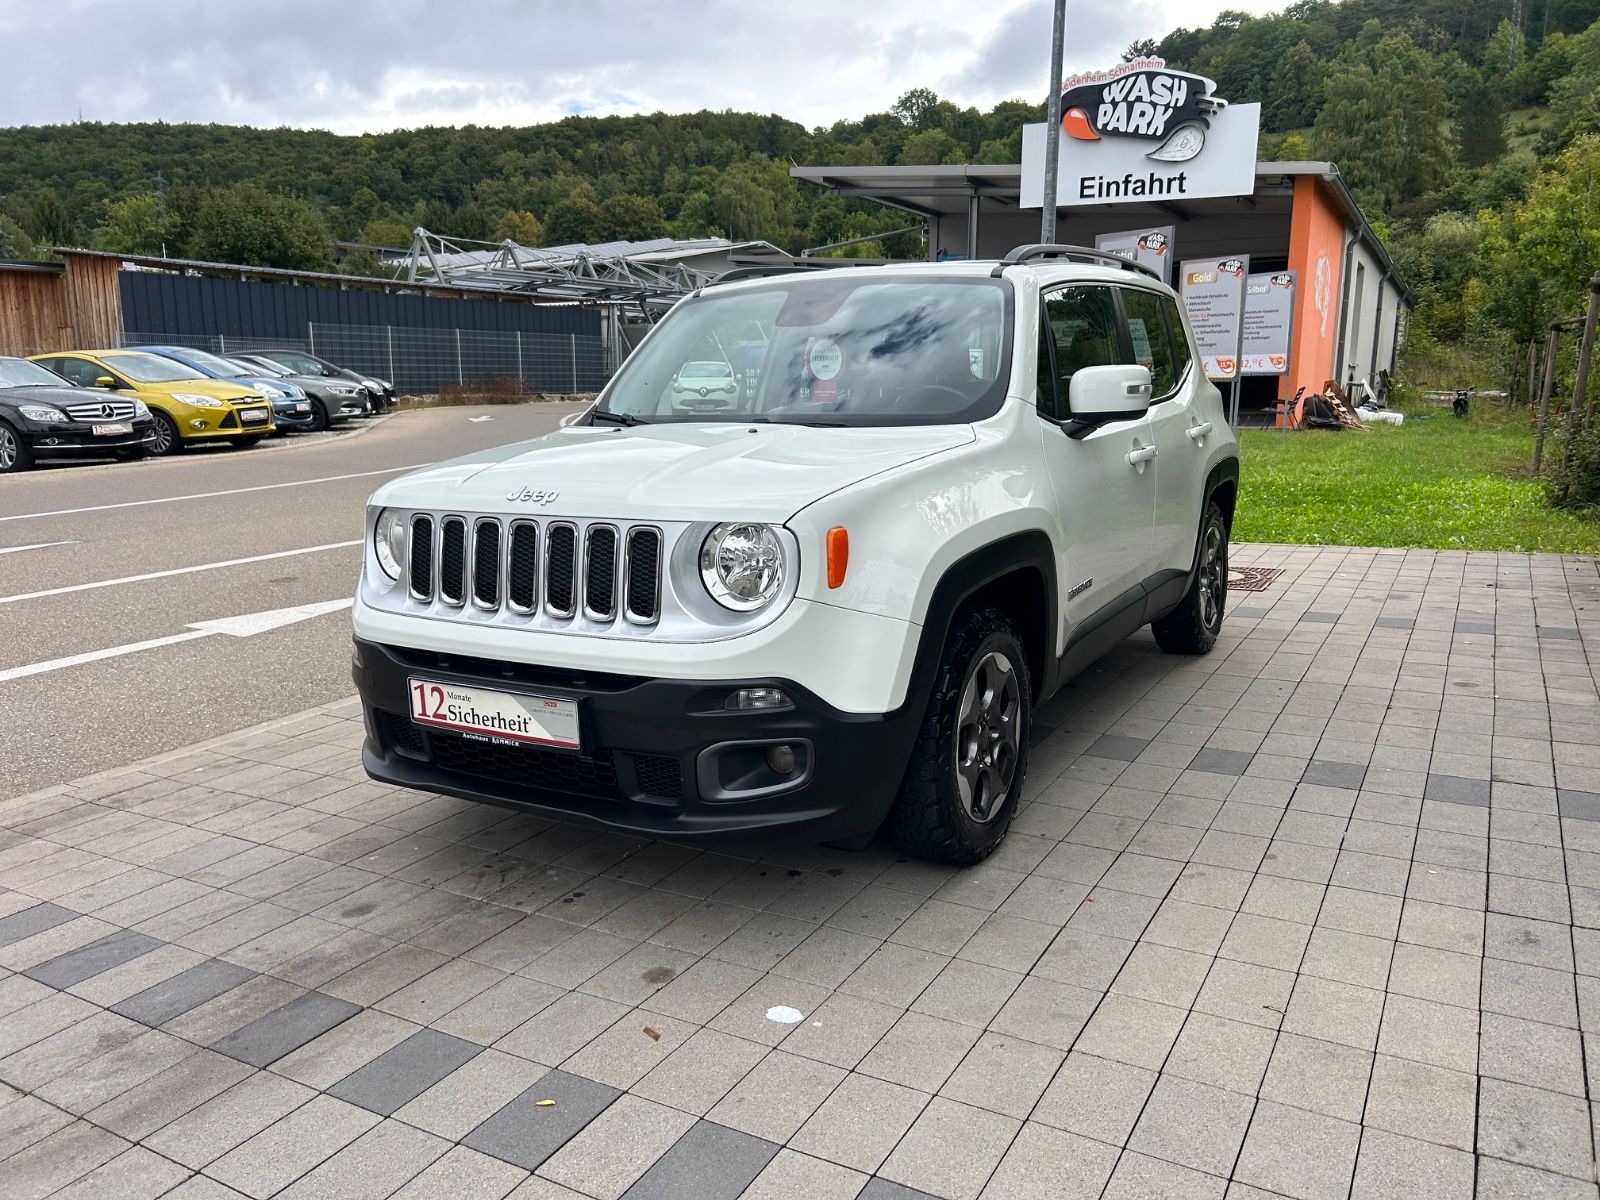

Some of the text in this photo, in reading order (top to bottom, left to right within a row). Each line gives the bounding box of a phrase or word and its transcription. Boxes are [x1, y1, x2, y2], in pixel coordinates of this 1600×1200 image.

[1061, 58, 1164, 92] eidenheim Schnaitheim
[1102, 73, 1187, 108] WASH
[1096, 101, 1174, 137] PARK
[1079, 171, 1187, 199] Einfahrt
[1192, 272, 1212, 283] Gold
[506, 485, 560, 506] Jeep
[413, 683, 448, 721] 12
[446, 690, 472, 703] Monate
[462, 732, 489, 742] Autohaus
